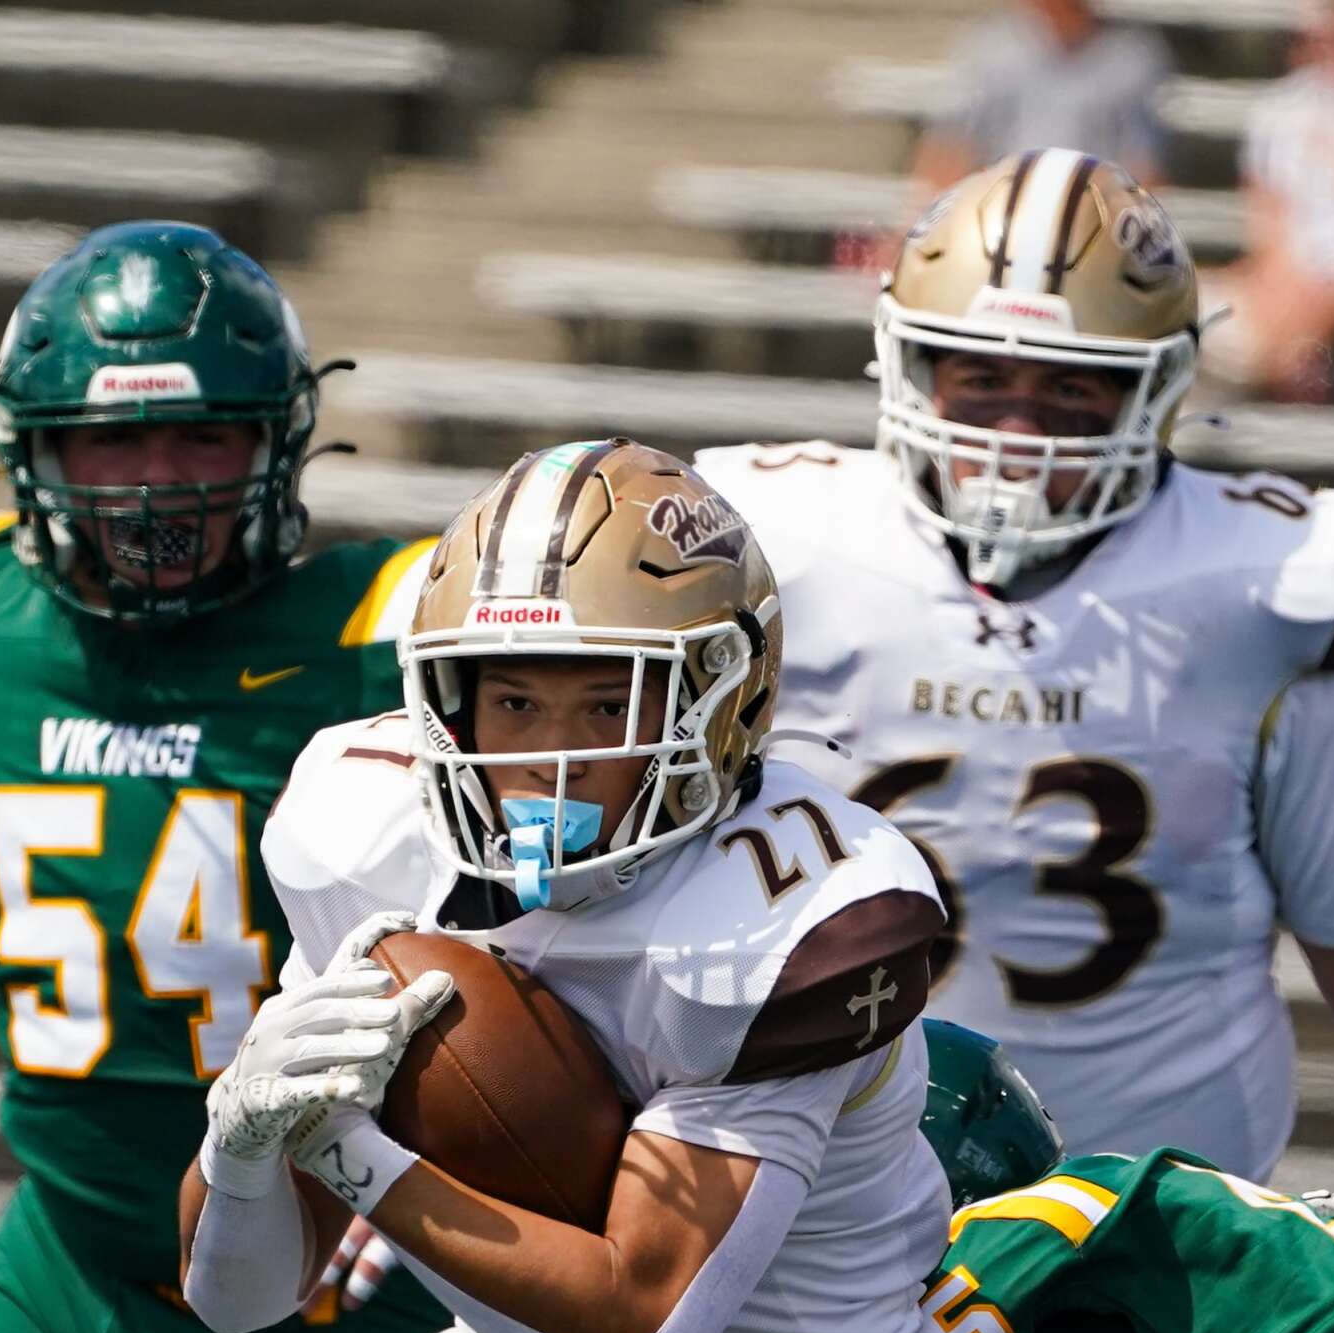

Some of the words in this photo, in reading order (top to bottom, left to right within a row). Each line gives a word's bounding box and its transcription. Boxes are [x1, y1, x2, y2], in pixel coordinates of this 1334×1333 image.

[476, 606, 561, 624] Riddell
[912, 677, 1085, 724] BECAHI
[40, 716, 202, 777] VIKINGS
[716, 797, 851, 910] 27
